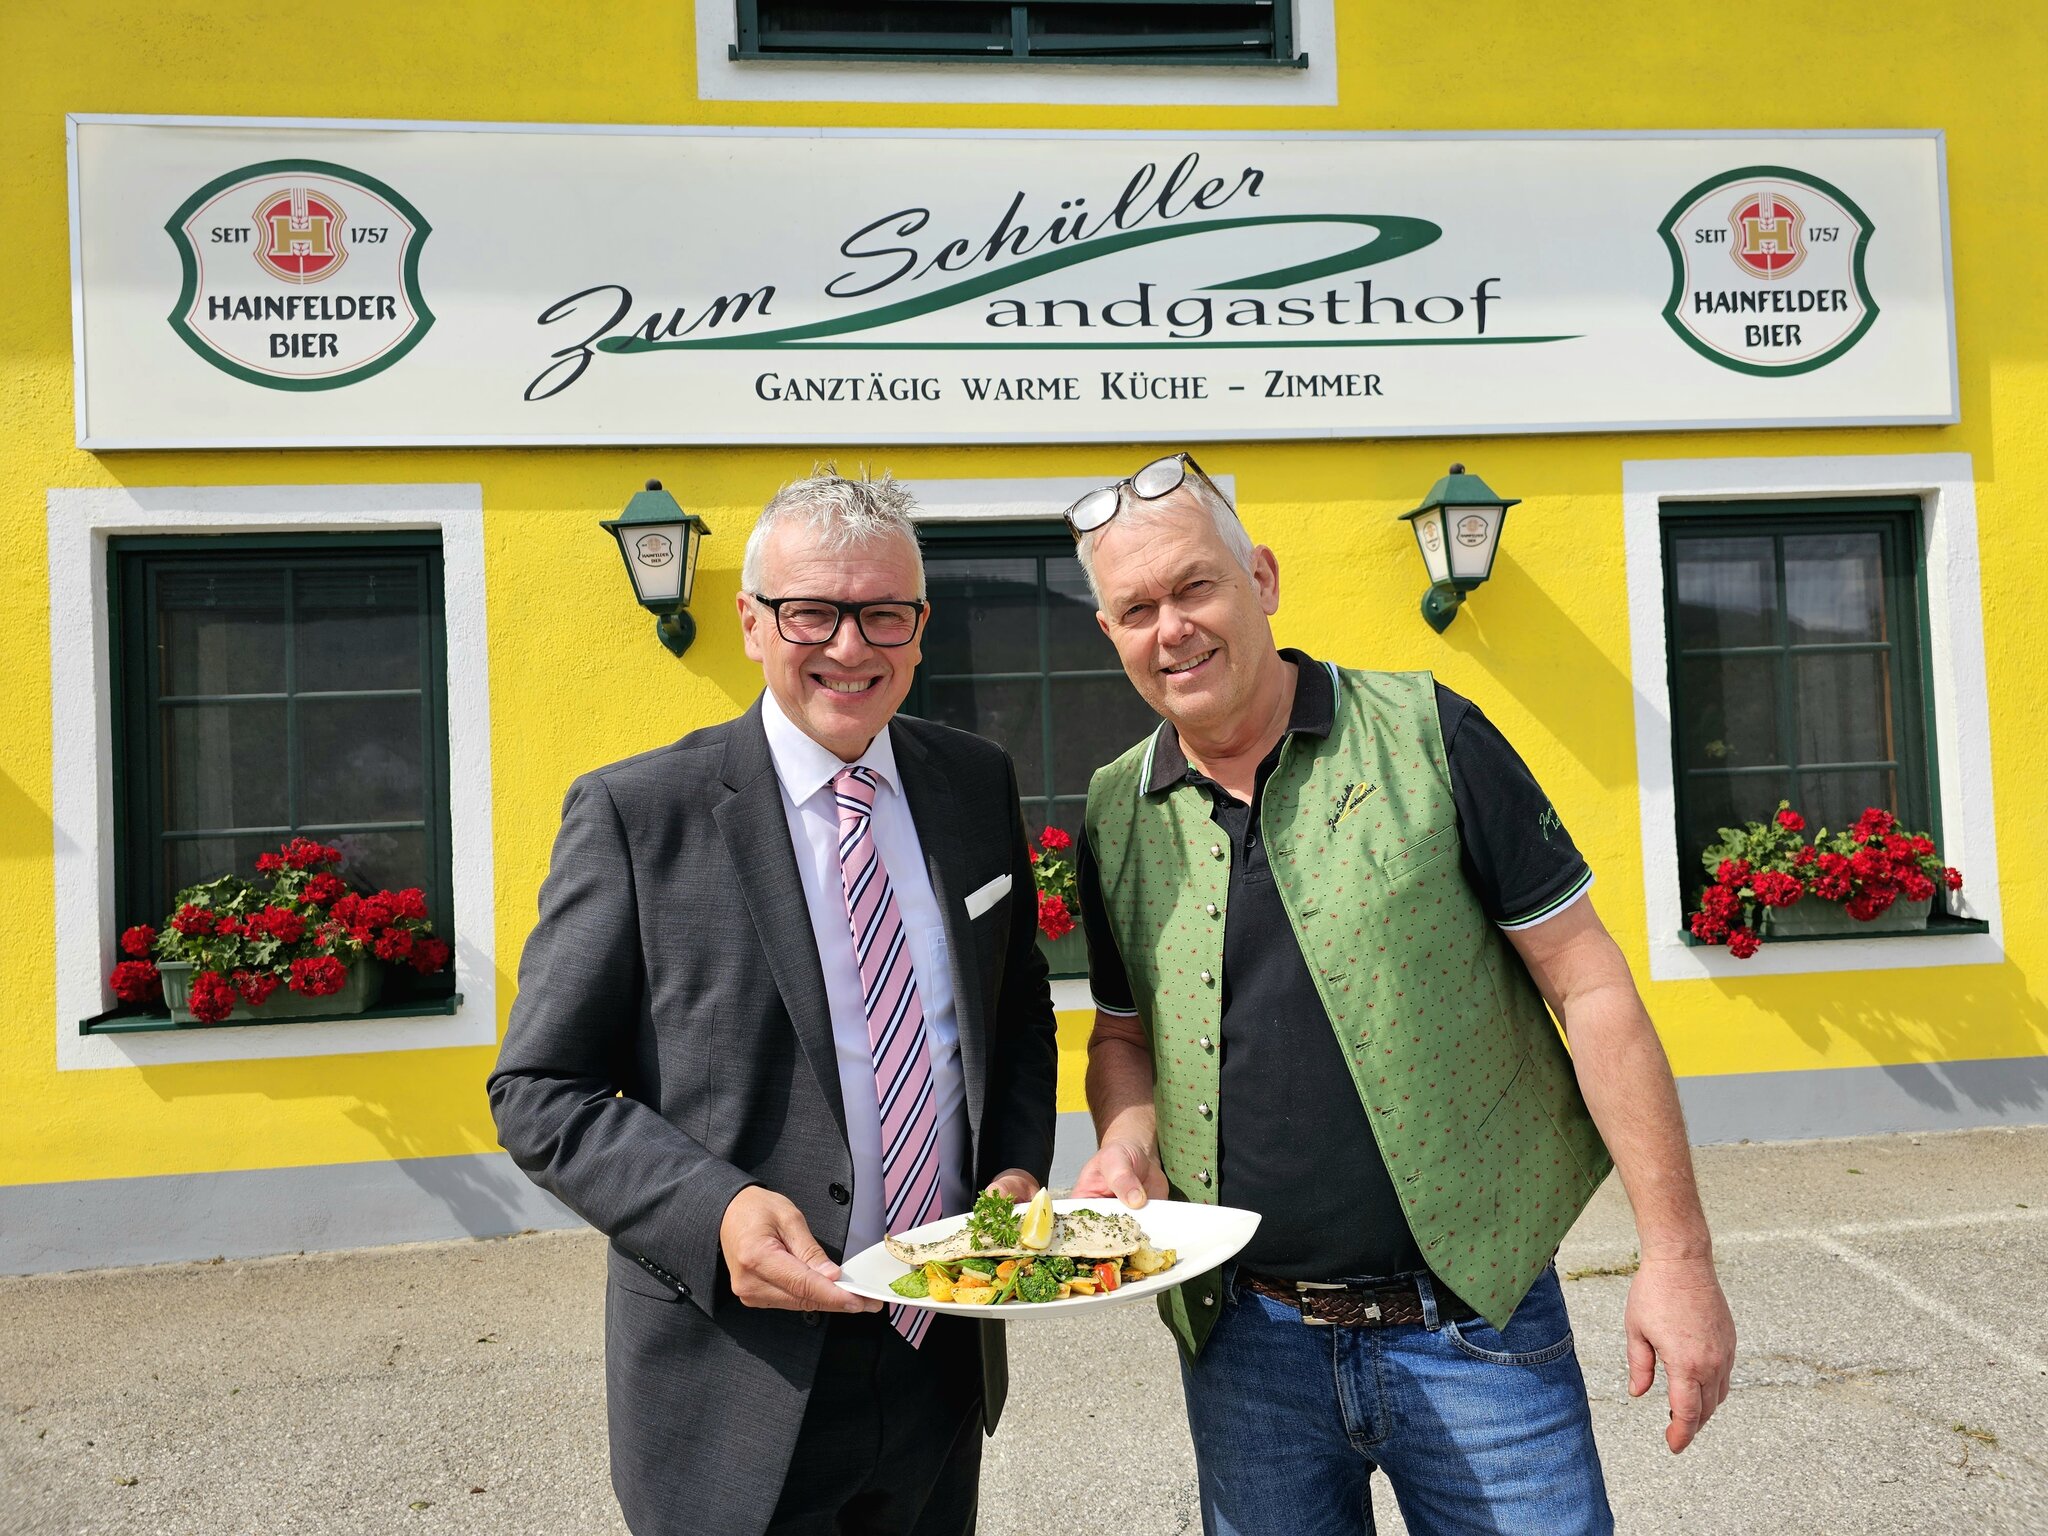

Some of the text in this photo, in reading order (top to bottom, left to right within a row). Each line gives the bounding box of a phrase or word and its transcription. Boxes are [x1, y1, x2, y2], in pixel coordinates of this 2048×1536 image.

[211, 227, 389, 244] SEIT 1757
[1695, 227, 1840, 244] SEIT 1757
[524, 151, 1265, 401] Zum Schüller
[208, 295, 397, 321] HAINFELDER
[1694, 289, 1848, 314] HAINFELDER
[269, 333, 339, 358] BIER
[1745, 324, 1802, 347] BIER
